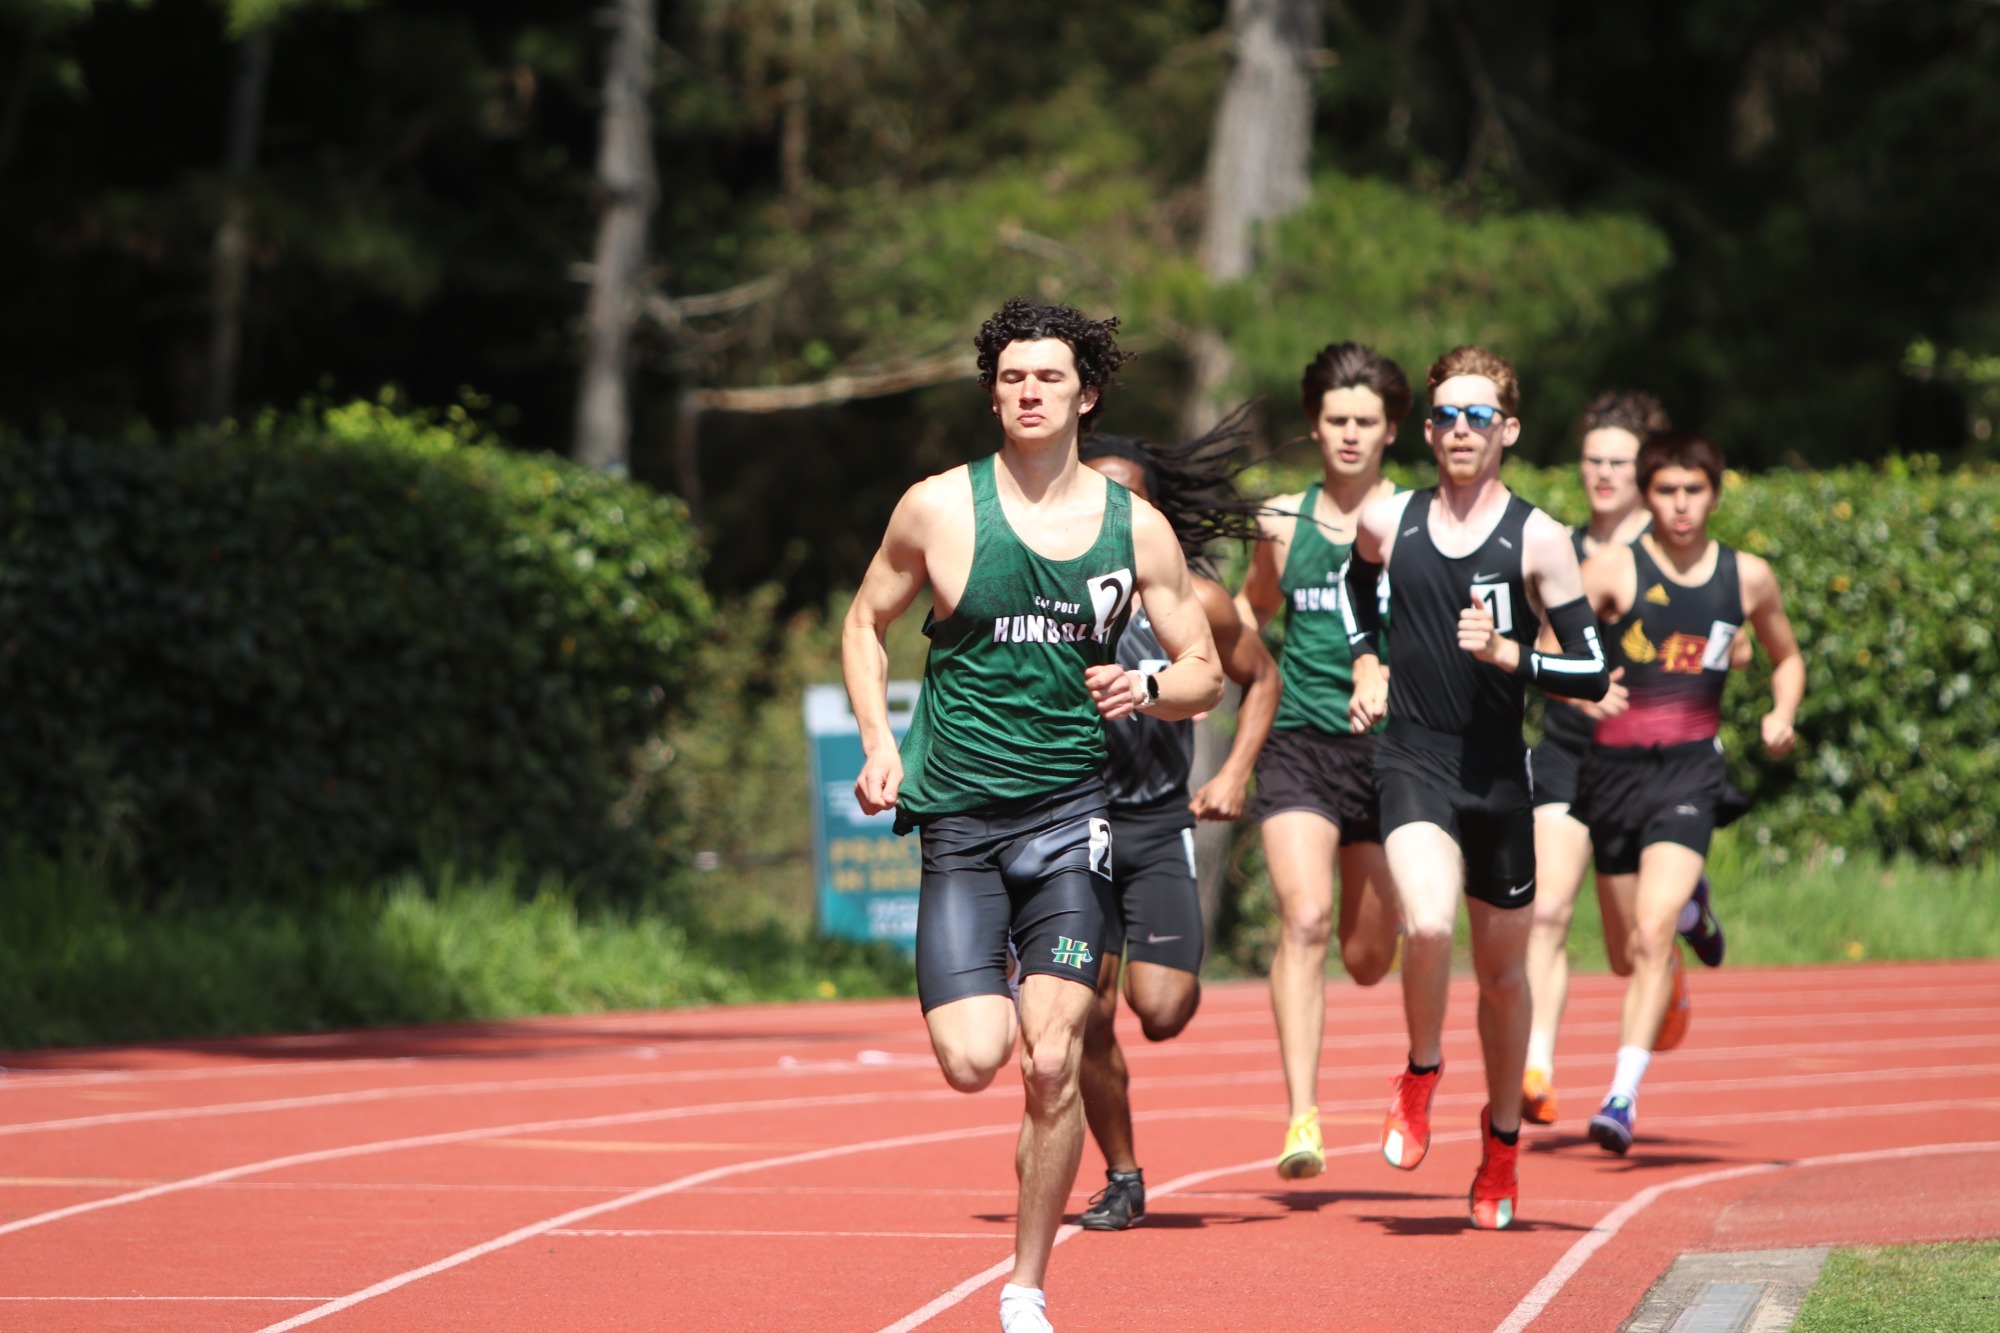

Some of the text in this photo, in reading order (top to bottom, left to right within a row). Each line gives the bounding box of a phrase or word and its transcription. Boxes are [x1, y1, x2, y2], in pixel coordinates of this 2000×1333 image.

[1054, 600, 1081, 615] POLY
[1099, 577, 1124, 630] 2
[1483, 588, 1500, 629] 1
[1098, 823, 1111, 878] 2
